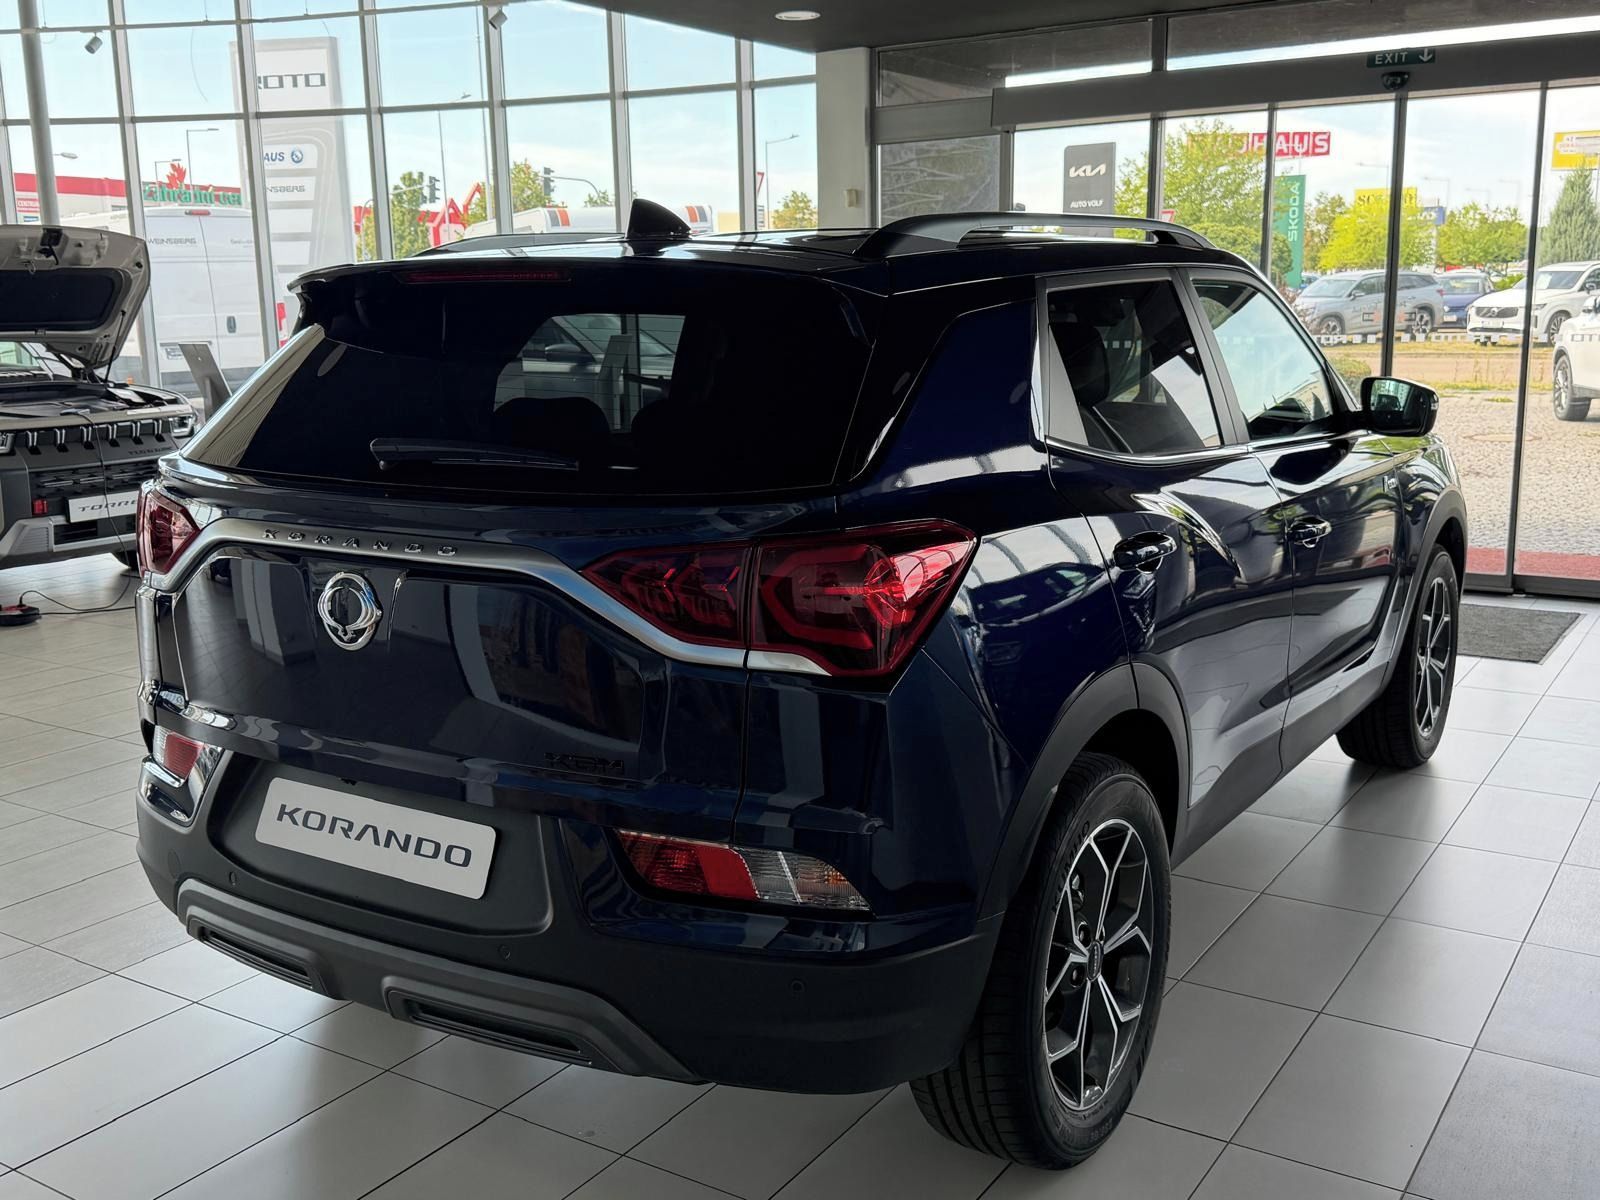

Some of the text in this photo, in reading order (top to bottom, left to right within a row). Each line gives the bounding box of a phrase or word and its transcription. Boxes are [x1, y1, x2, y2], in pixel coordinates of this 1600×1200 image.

[1375, 52, 1408, 64] EXIT
[1069, 163, 1106, 178] KIA
[263, 528, 457, 557] KORANDO
[276, 803, 472, 869] KORANDO
